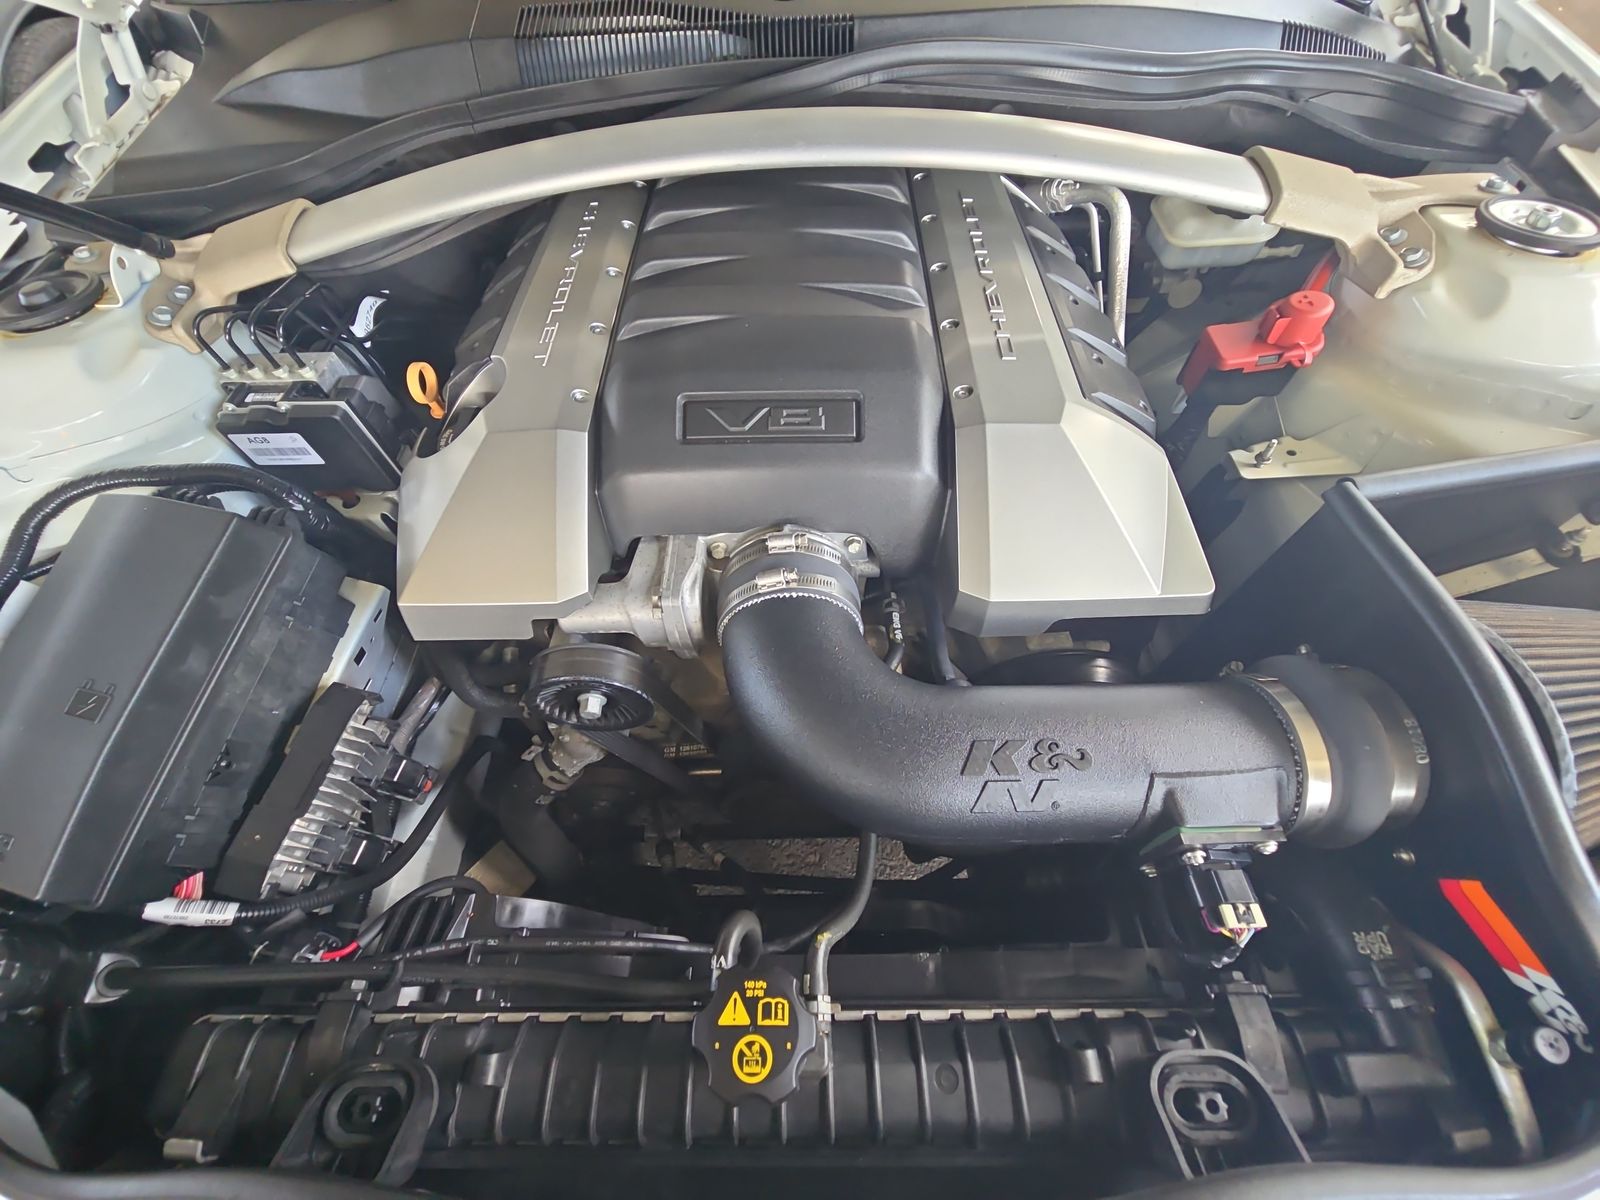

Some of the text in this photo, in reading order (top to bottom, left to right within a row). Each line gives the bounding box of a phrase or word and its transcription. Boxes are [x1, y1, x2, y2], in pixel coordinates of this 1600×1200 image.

[704, 406, 826, 432] V8
[744, 980, 755, 989] 140
[745, 989, 764, 997] 20 PSI
